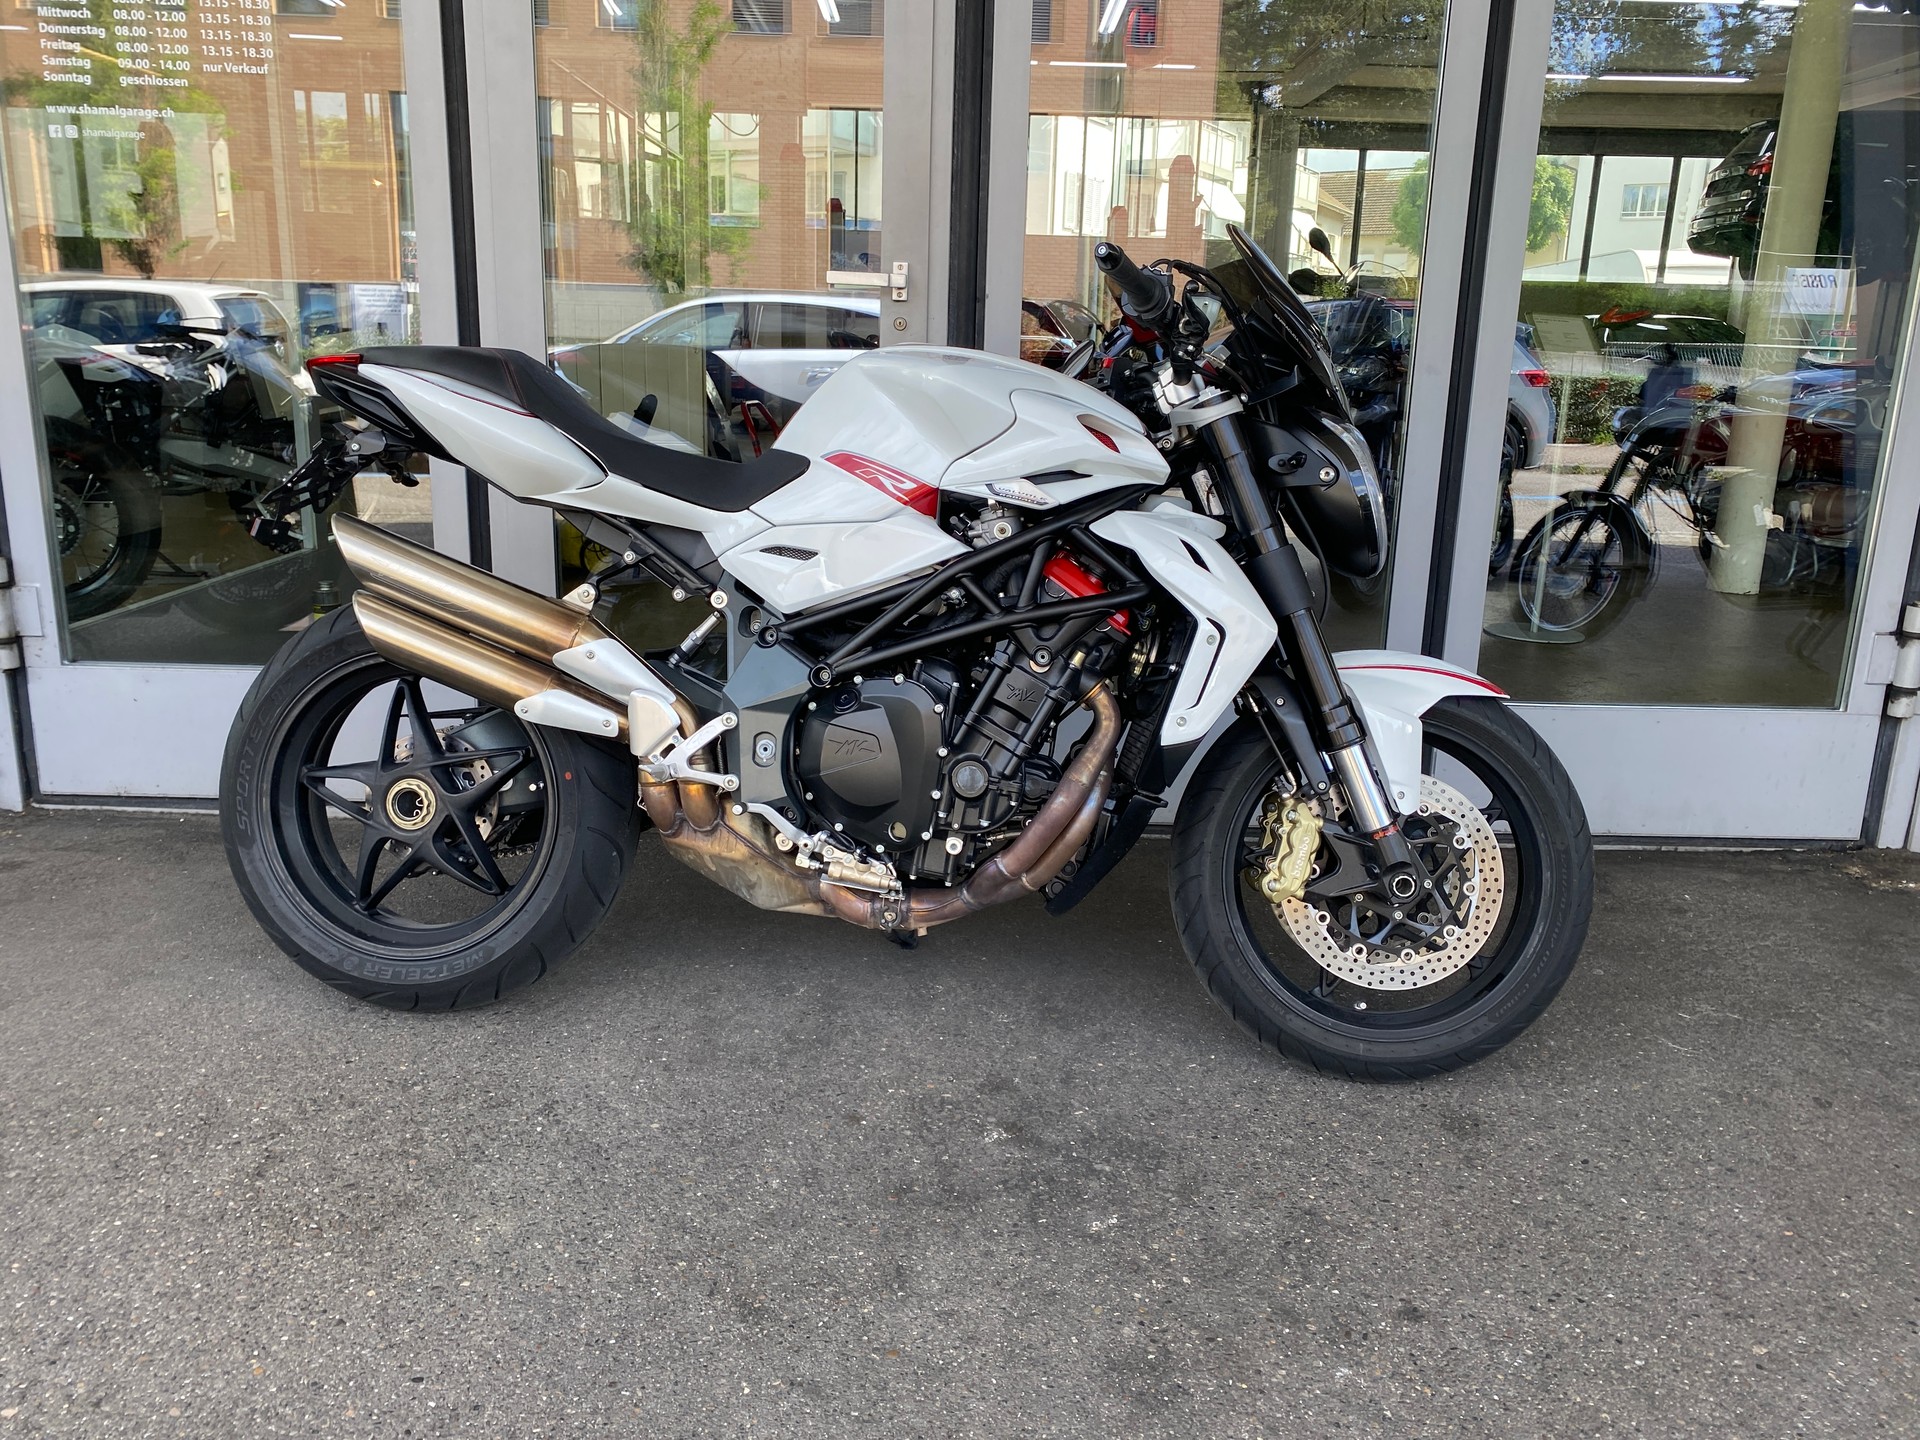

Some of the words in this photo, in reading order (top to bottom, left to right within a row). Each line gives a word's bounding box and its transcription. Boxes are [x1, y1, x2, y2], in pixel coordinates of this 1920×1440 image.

[199, 0, 229, 8] 13.15
[239, 0, 271, 9] 18.30
[37, 6, 91, 19] Mittwoch
[113, 9, 146, 21] 08.00
[154, 11, 186, 22] 12.00
[199, 13, 231, 24] 13.15
[239, 15, 271, 26] 18.30
[38, 22, 106, 38] Donnerstag
[114, 25, 147, 37] 08.00
[155, 27, 188, 39] 12.00
[200, 29, 232, 41] 13.15
[240, 31, 273, 42] 18.30
[40, 38, 81, 53] Freitag
[116, 41, 149, 53] 08.00
[157, 43, 189, 55] 12.00
[201, 45, 234, 57] 13.15
[242, 47, 274, 58] 18.30
[41, 54, 92, 69] Samstag
[117, 58, 150, 69] 09.00
[158, 59, 191, 71] 14.00
[202, 65, 222, 73] nur
[224, 62, 269, 74] Verkauf
[43, 70, 92, 85] Sonntag
[119, 74, 189, 87] geschlossen
[45, 103, 175, 119] www.shamalgarage.ch
[82, 127, 146, 141] shamalgarage
[1291, 836, 1310, 878] brembo
[363, 951, 484, 981] METZELER
